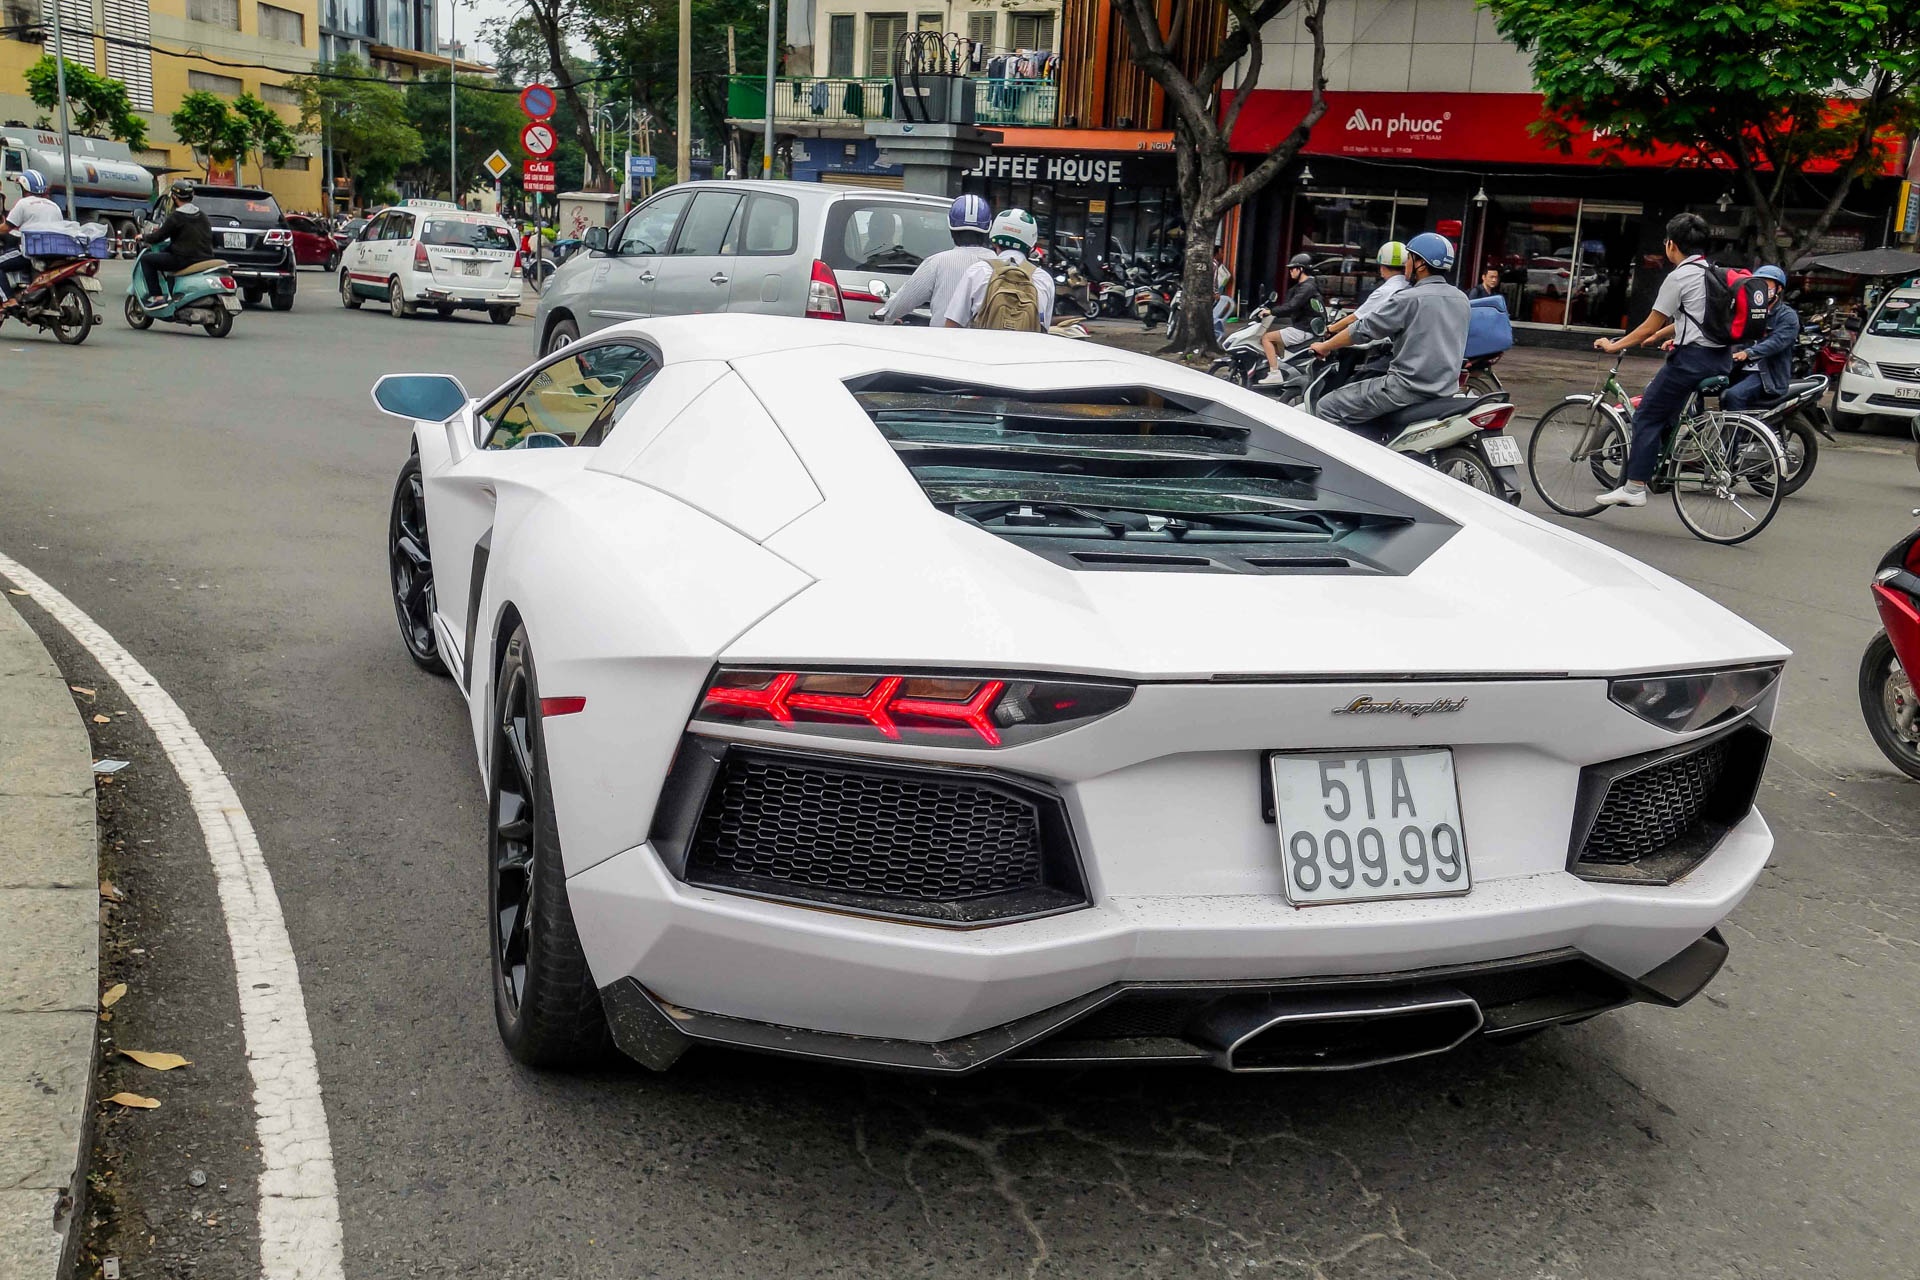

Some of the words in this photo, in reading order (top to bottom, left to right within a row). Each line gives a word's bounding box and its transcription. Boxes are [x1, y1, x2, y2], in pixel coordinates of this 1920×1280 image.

[1345, 108, 1383, 131] An
[1386, 112, 1443, 138] phuoc
[962, 156, 1039, 179] OFFEE
[1047, 158, 1122, 183] HOUSE
[1331, 694, 1469, 719] Lamborghini
[1318, 758, 1417, 821] 51A
[1290, 822, 1462, 892] 899.99
